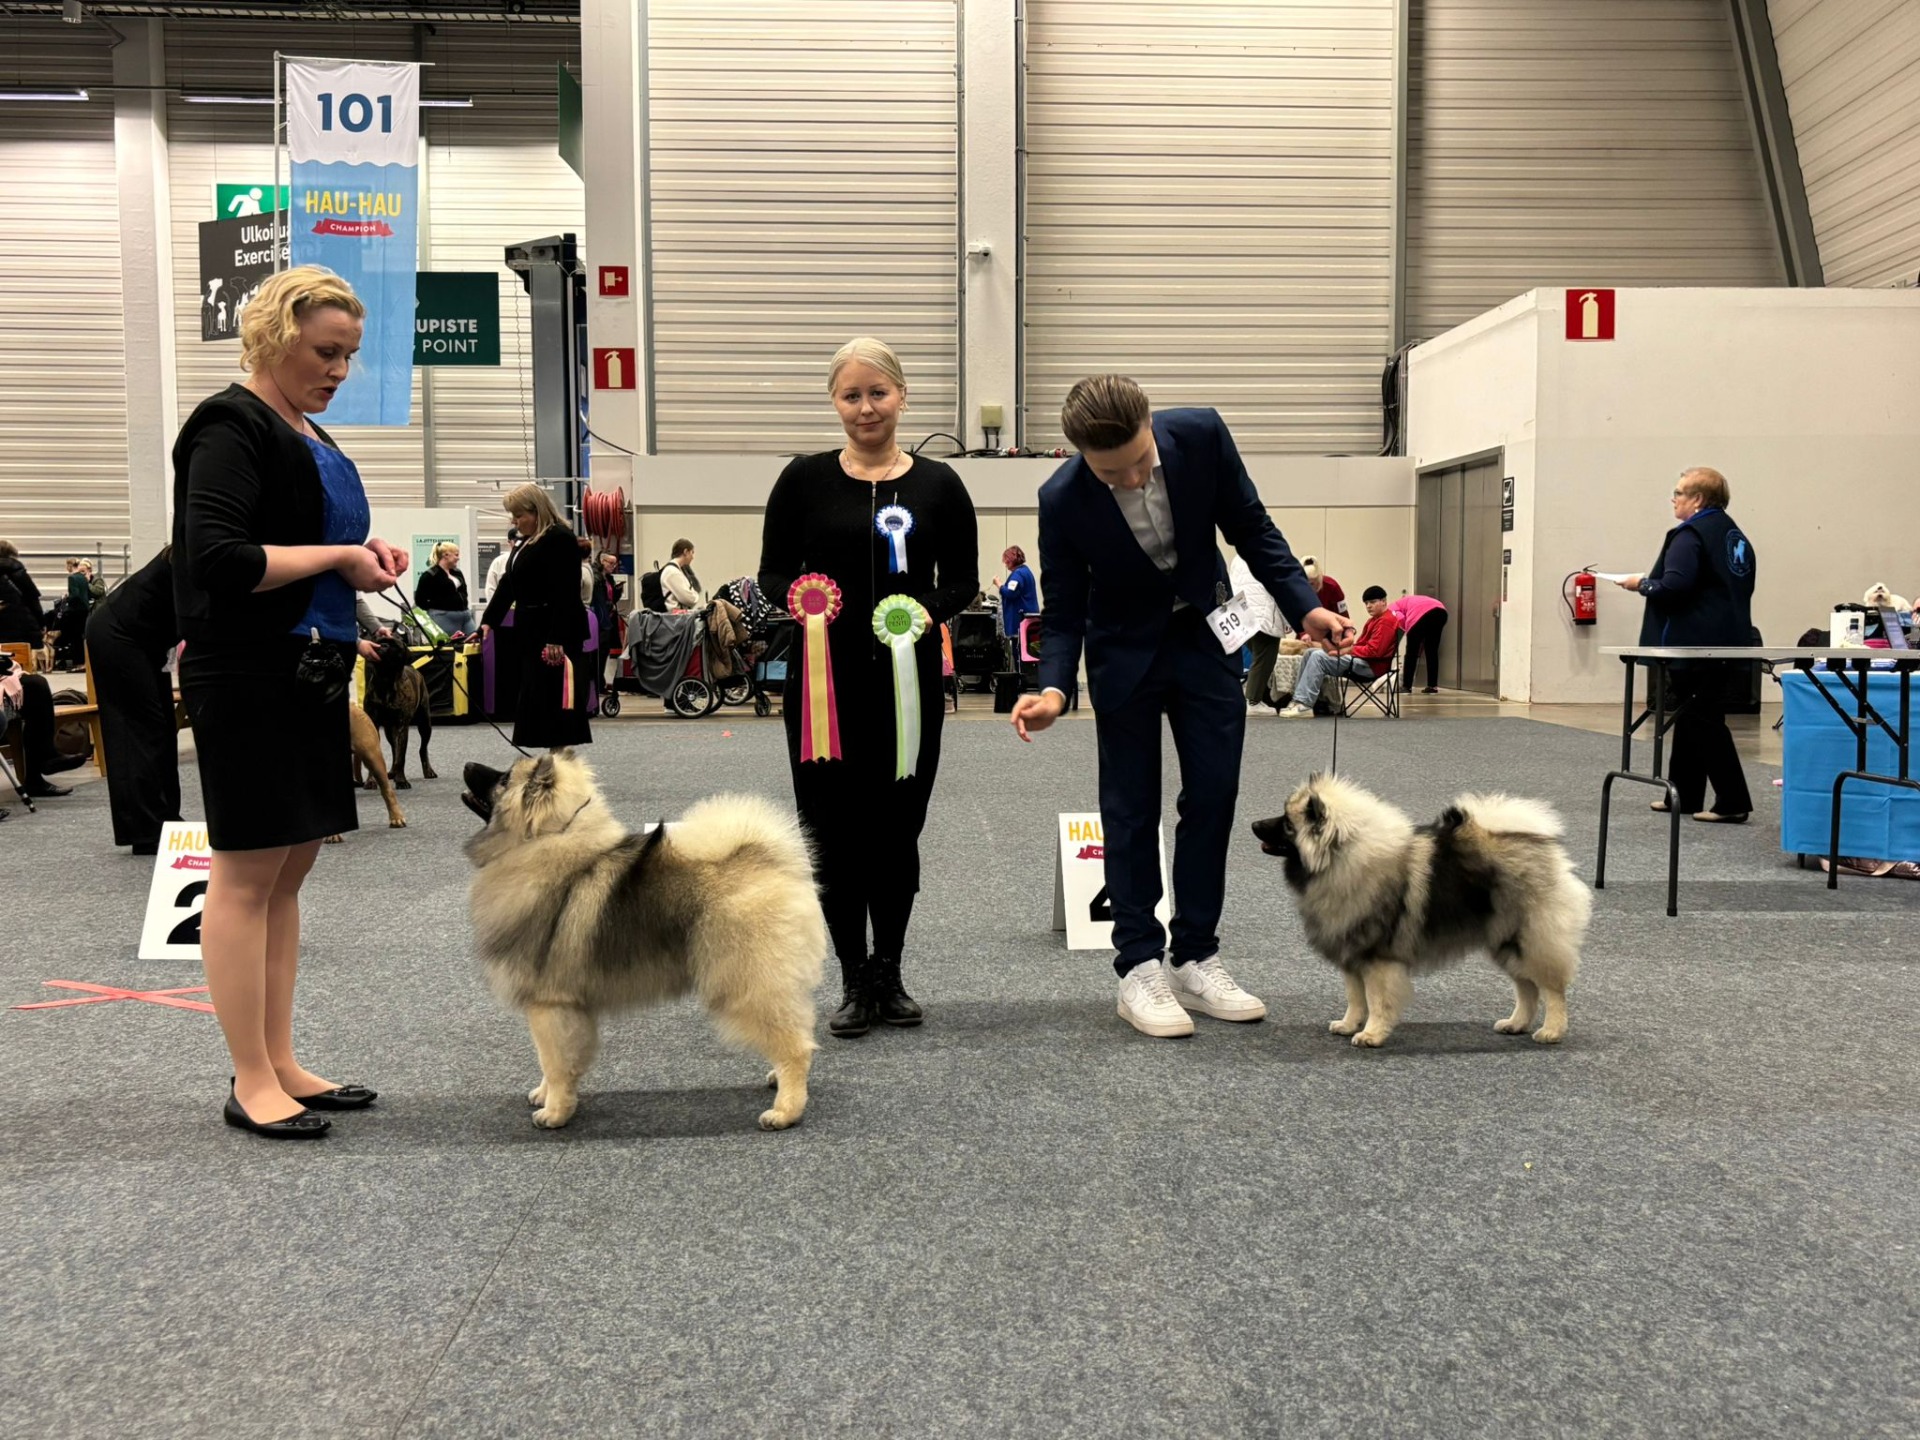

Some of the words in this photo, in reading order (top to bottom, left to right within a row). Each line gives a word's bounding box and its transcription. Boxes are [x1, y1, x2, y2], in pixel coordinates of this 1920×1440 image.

[317, 93, 392, 133] 101
[305, 190, 402, 217] HAU-HAU
[241, 222, 291, 244] Ulkoiu
[330, 223, 377, 233] CHAMPION
[235, 245, 289, 267] Exercie
[422, 339, 478, 353] POINT
[1219, 612, 1241, 636] 519
